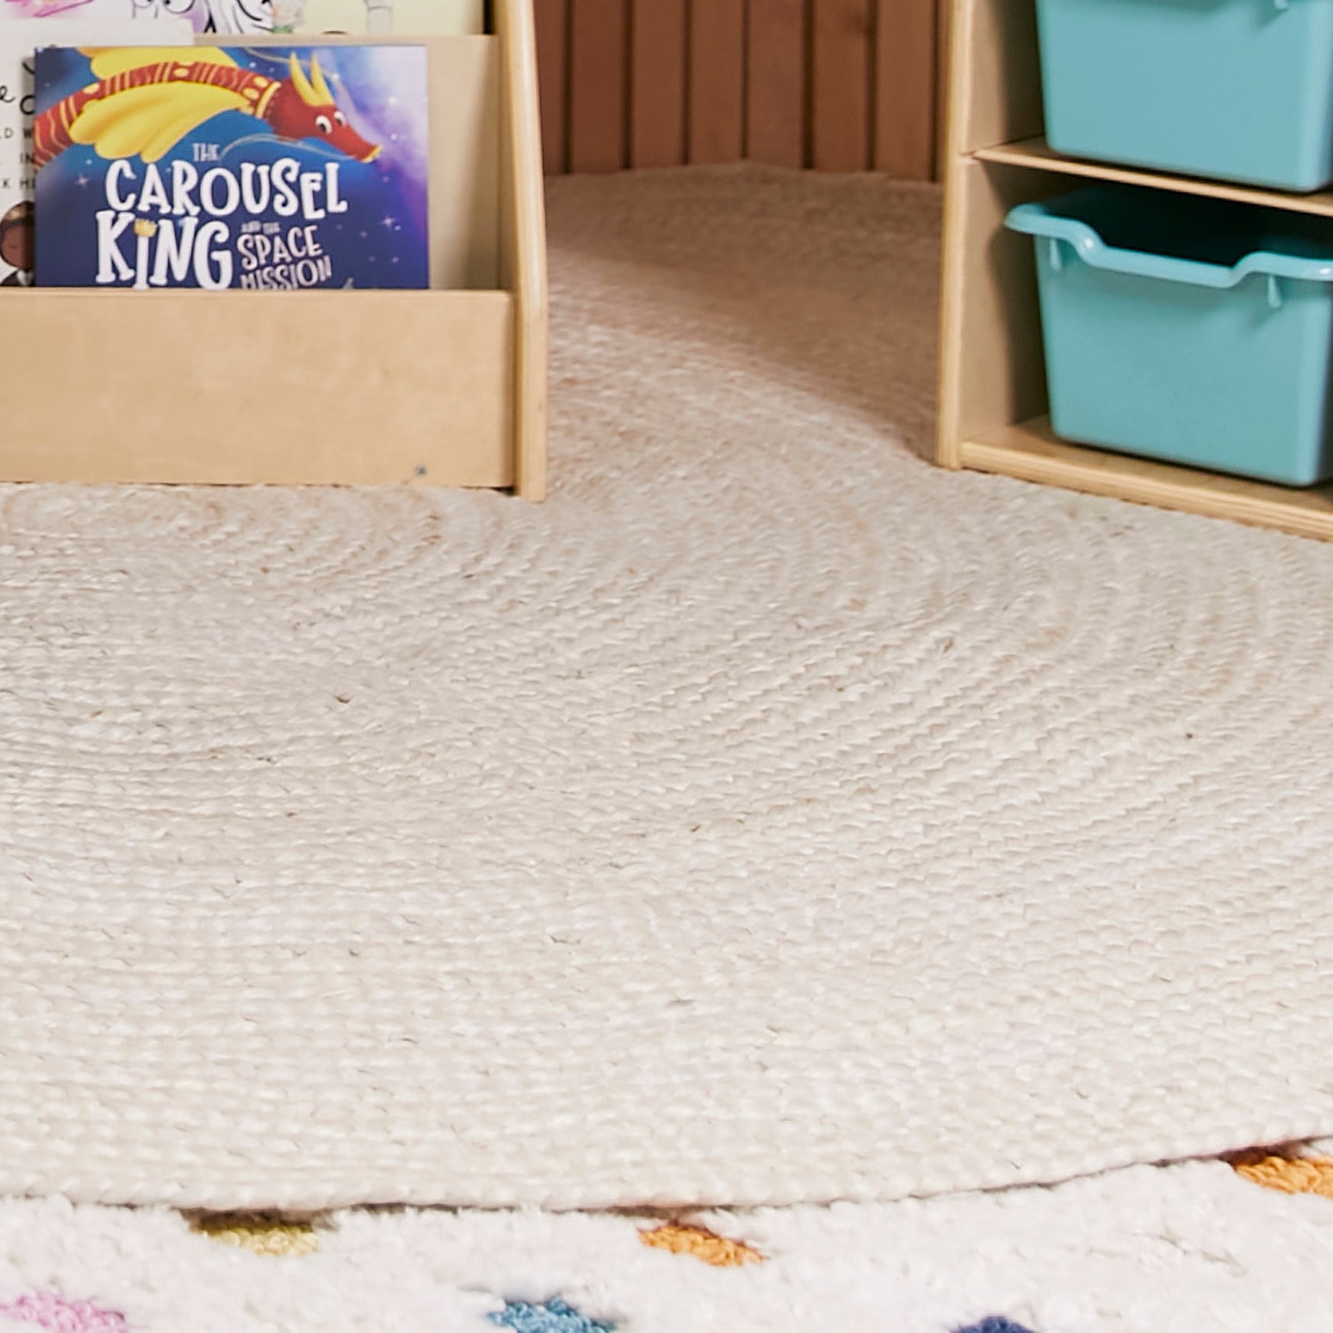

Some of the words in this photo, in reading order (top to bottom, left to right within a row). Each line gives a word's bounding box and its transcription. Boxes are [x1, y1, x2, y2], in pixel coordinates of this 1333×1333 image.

[191, 142, 221, 162] THE
[105, 157, 348, 220] CAROUSEL
[95, 209, 233, 290] KING
[236, 224, 324, 271] SPACE
[239, 254, 332, 290] MISSION
